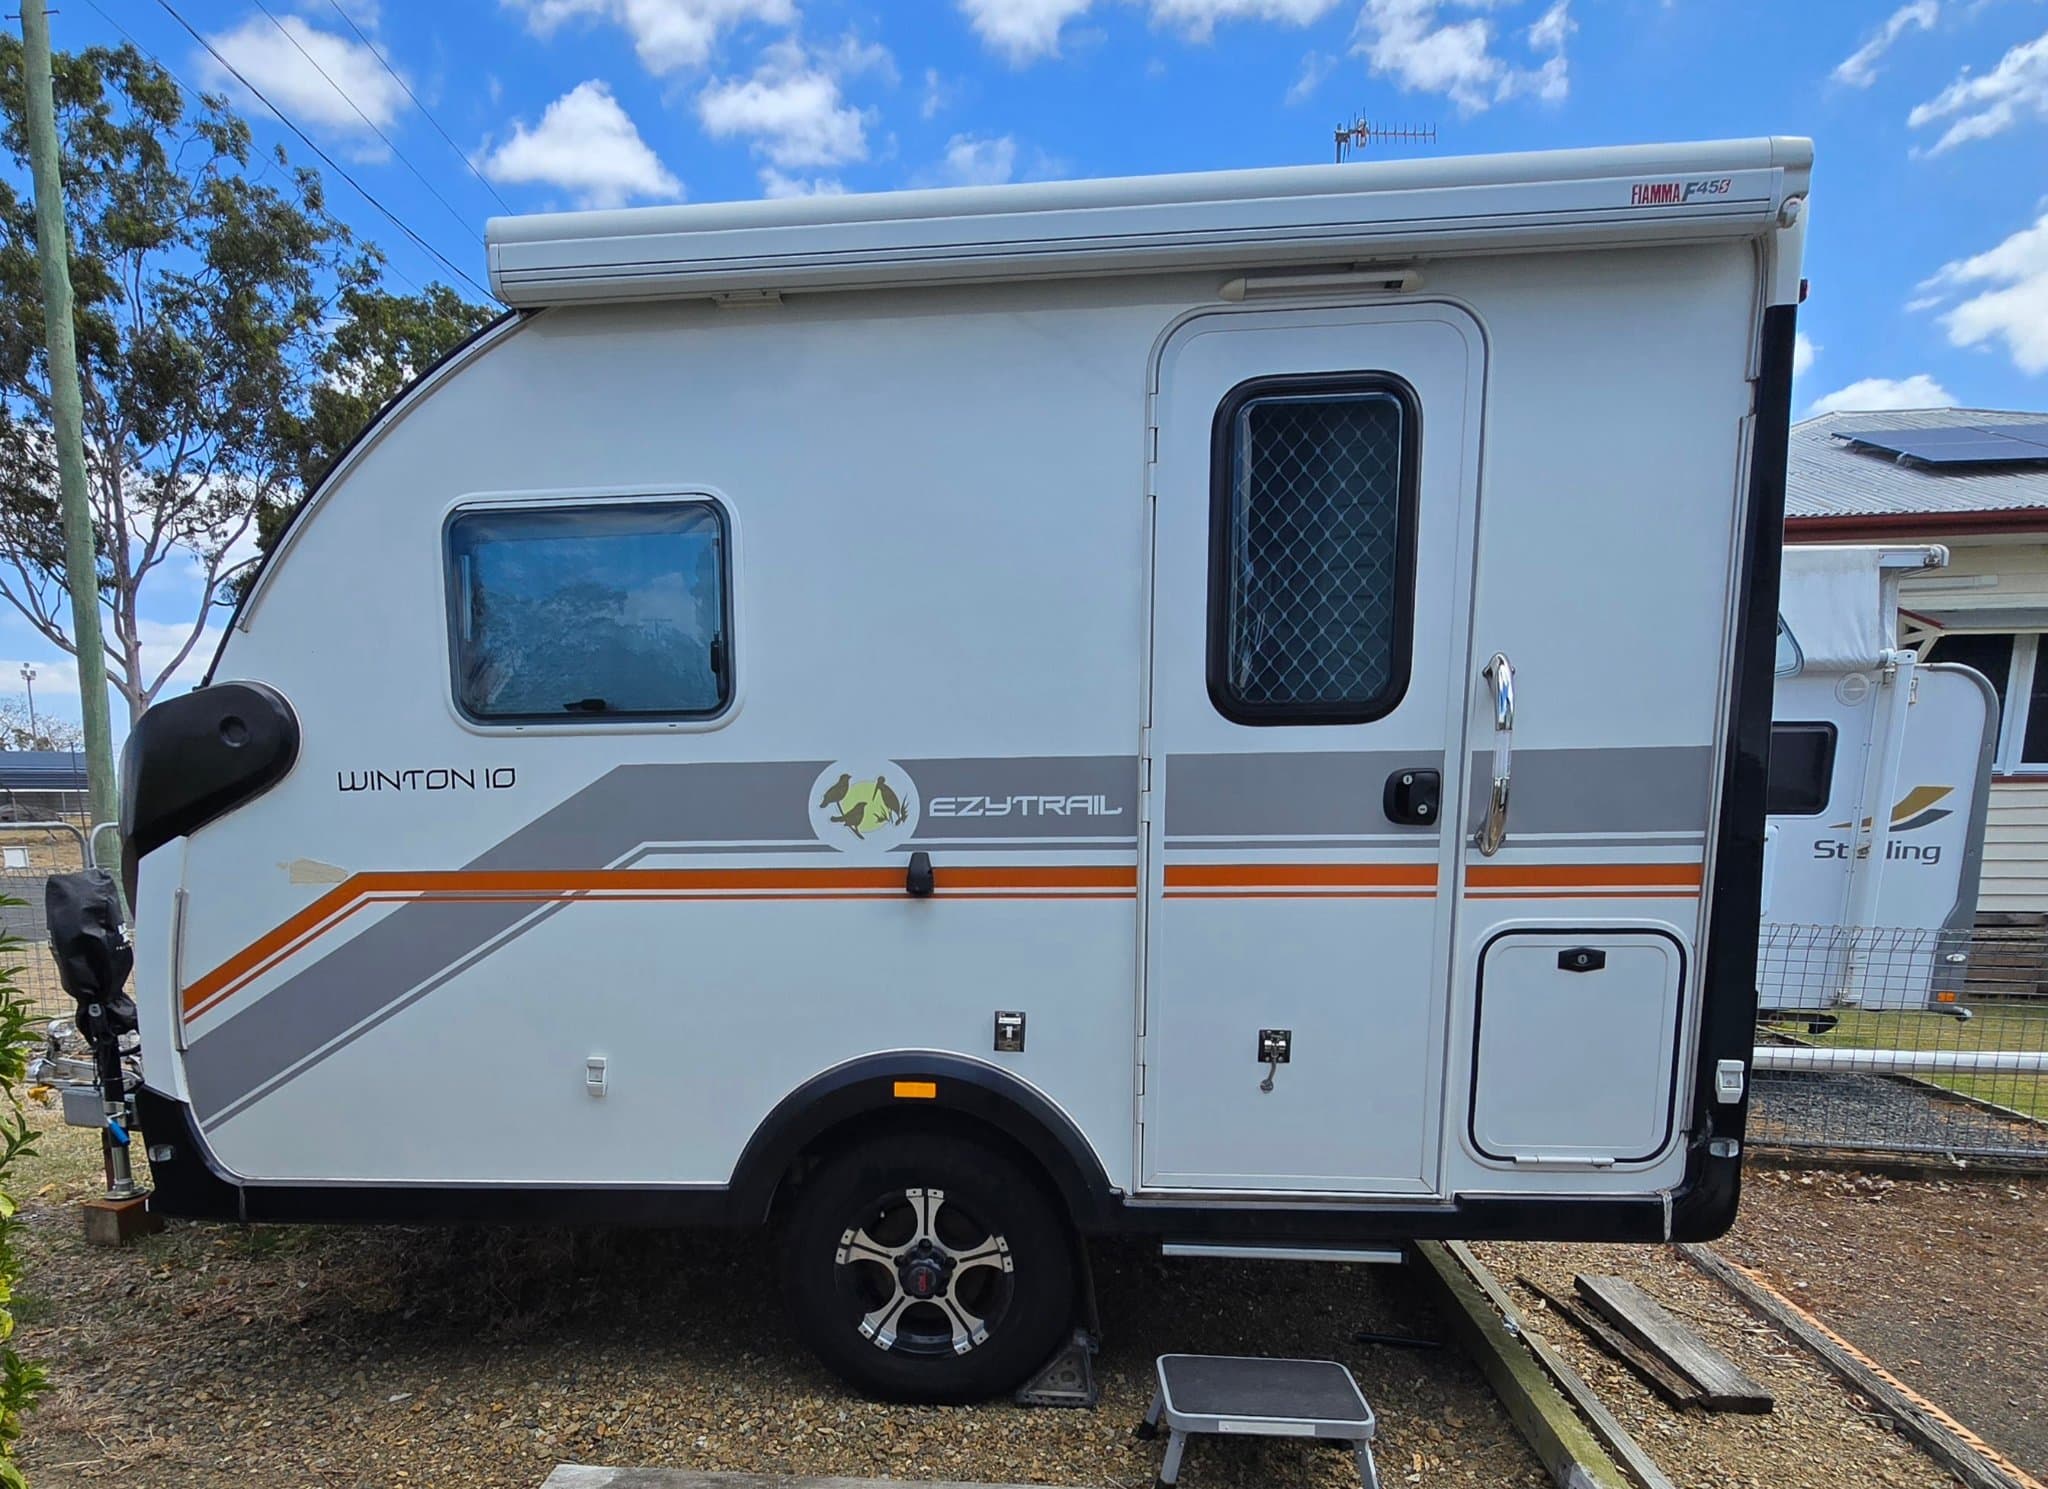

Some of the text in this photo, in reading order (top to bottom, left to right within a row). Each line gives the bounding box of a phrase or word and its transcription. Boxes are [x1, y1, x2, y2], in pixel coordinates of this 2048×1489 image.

[1631, 183, 1680, 205] FIAMMA
[337, 768, 476, 792] WINTON
[928, 794, 1124, 817] EZYTRAIL
